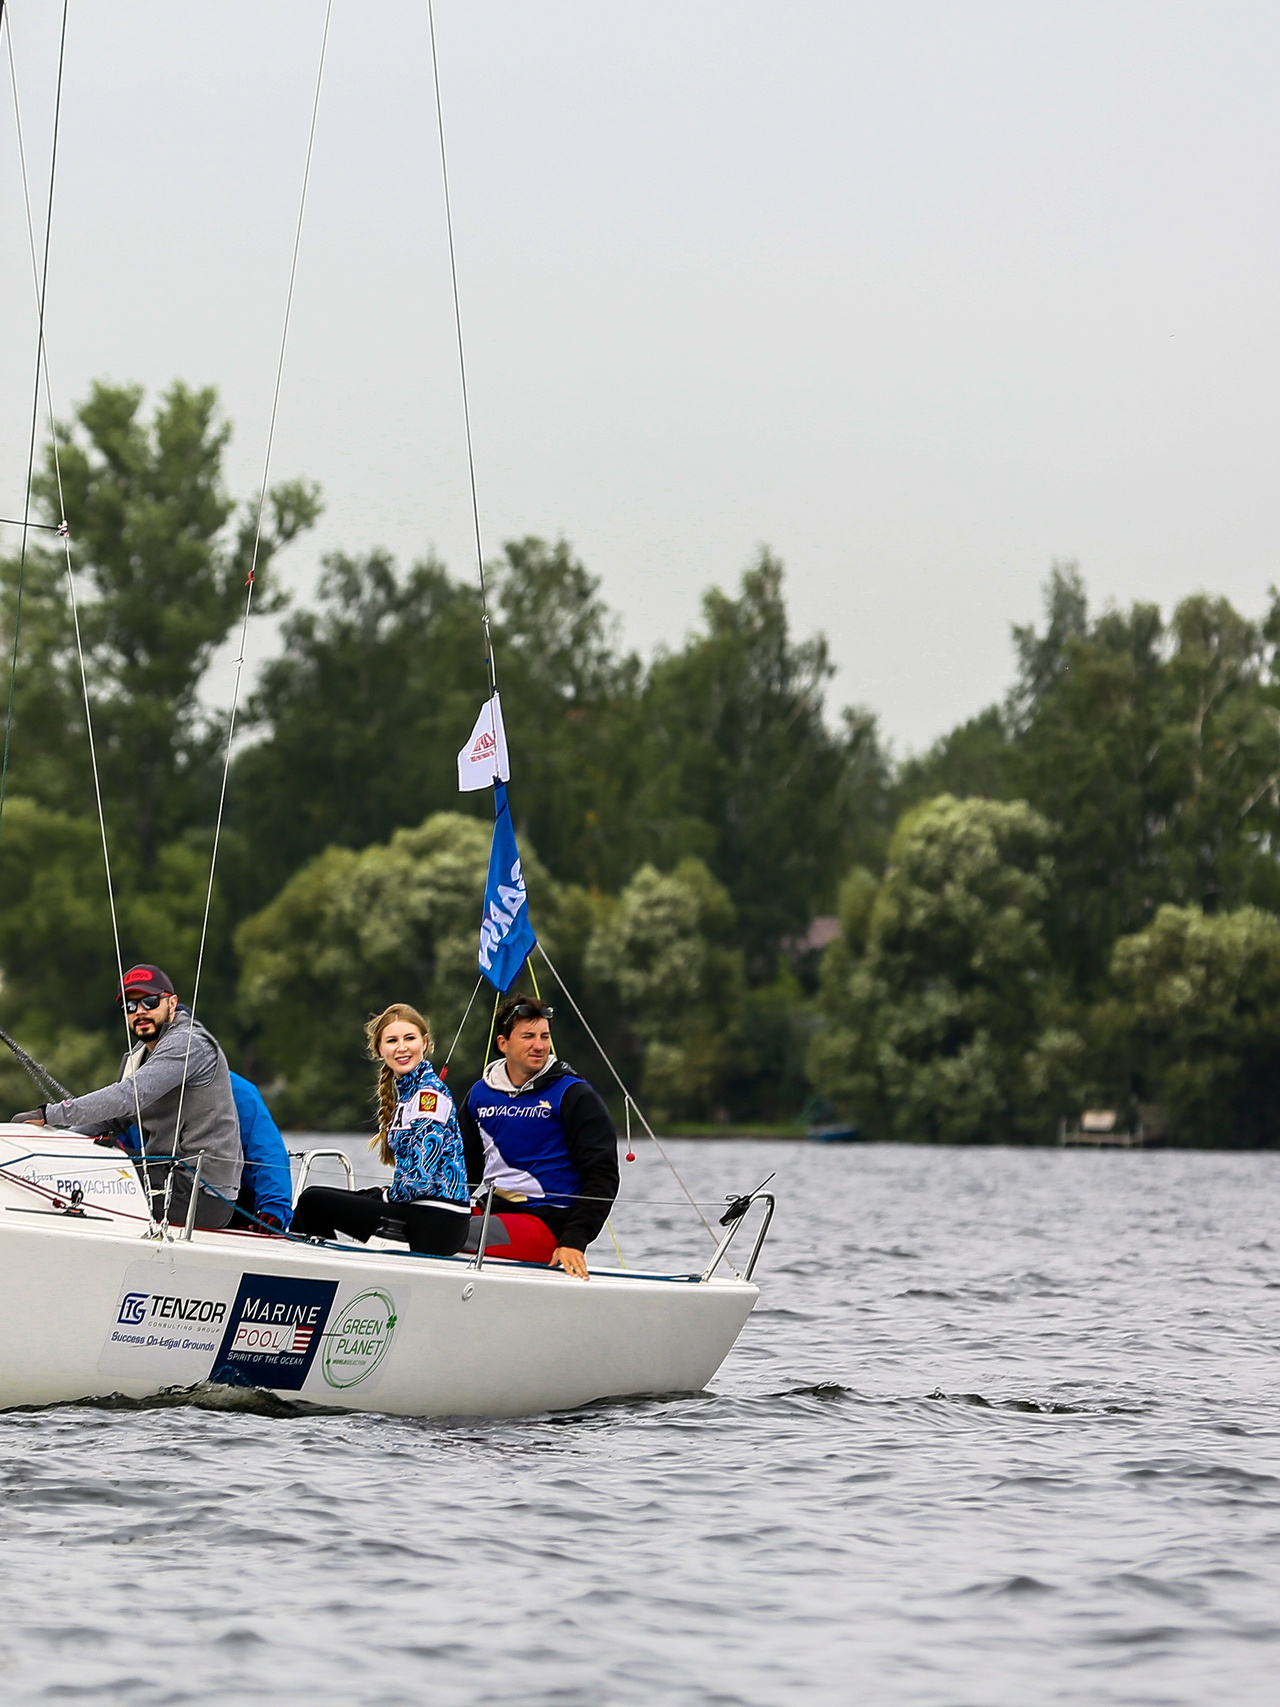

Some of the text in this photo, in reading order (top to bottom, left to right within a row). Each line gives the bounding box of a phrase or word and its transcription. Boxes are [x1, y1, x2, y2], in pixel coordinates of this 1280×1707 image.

[151, 1295, 227, 1323] TENZOR
[241, 1297, 321, 1324] MARINE
[342, 1318, 384, 1335] GREEN
[111, 1331, 215, 1352] Success On Legal Grounds
[234, 1329, 280, 1348] POOL
[335, 1338, 384, 1355] PLANET
[227, 1352, 304, 1366] SPIRIT OF THE OCEAN
